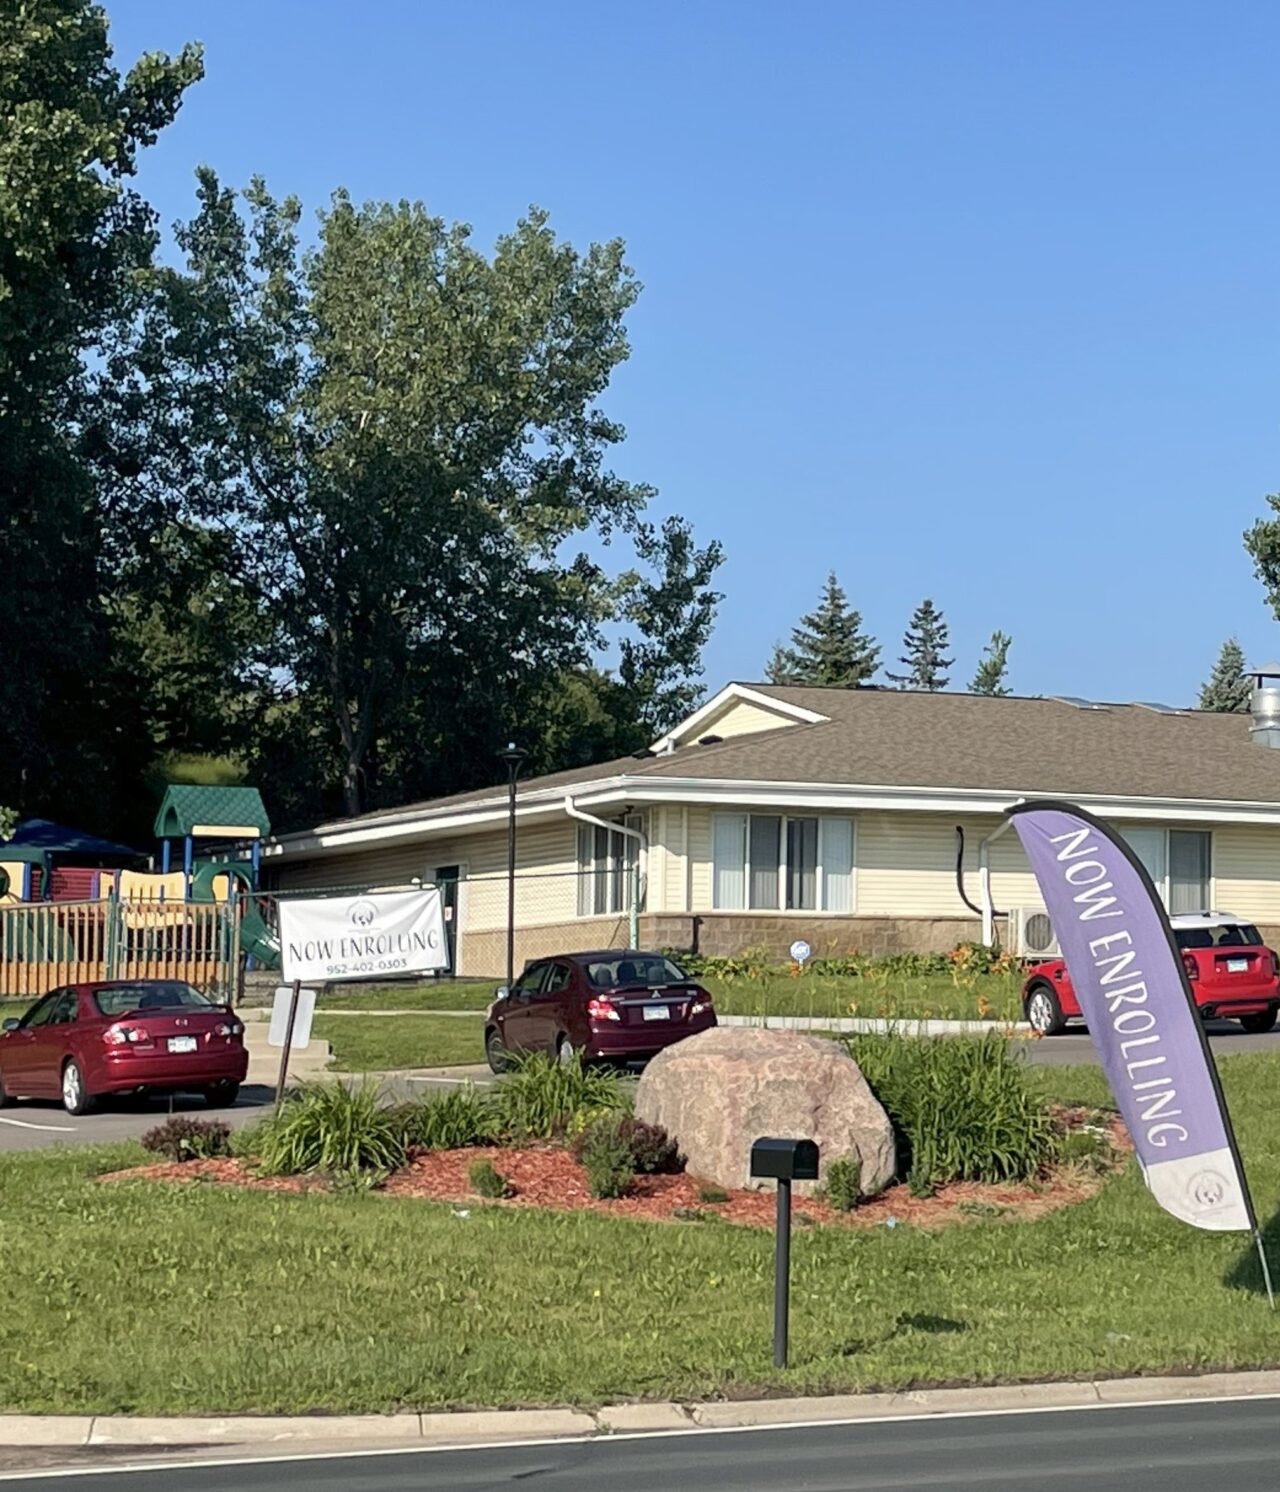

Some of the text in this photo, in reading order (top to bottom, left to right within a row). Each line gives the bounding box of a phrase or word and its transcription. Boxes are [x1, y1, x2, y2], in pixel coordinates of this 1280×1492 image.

[289, 930, 438, 963] NOW ENROLLING
[326, 958, 408, 975] 952-402-0303
[1049, 828, 1189, 1148] NOW ENROLLING
